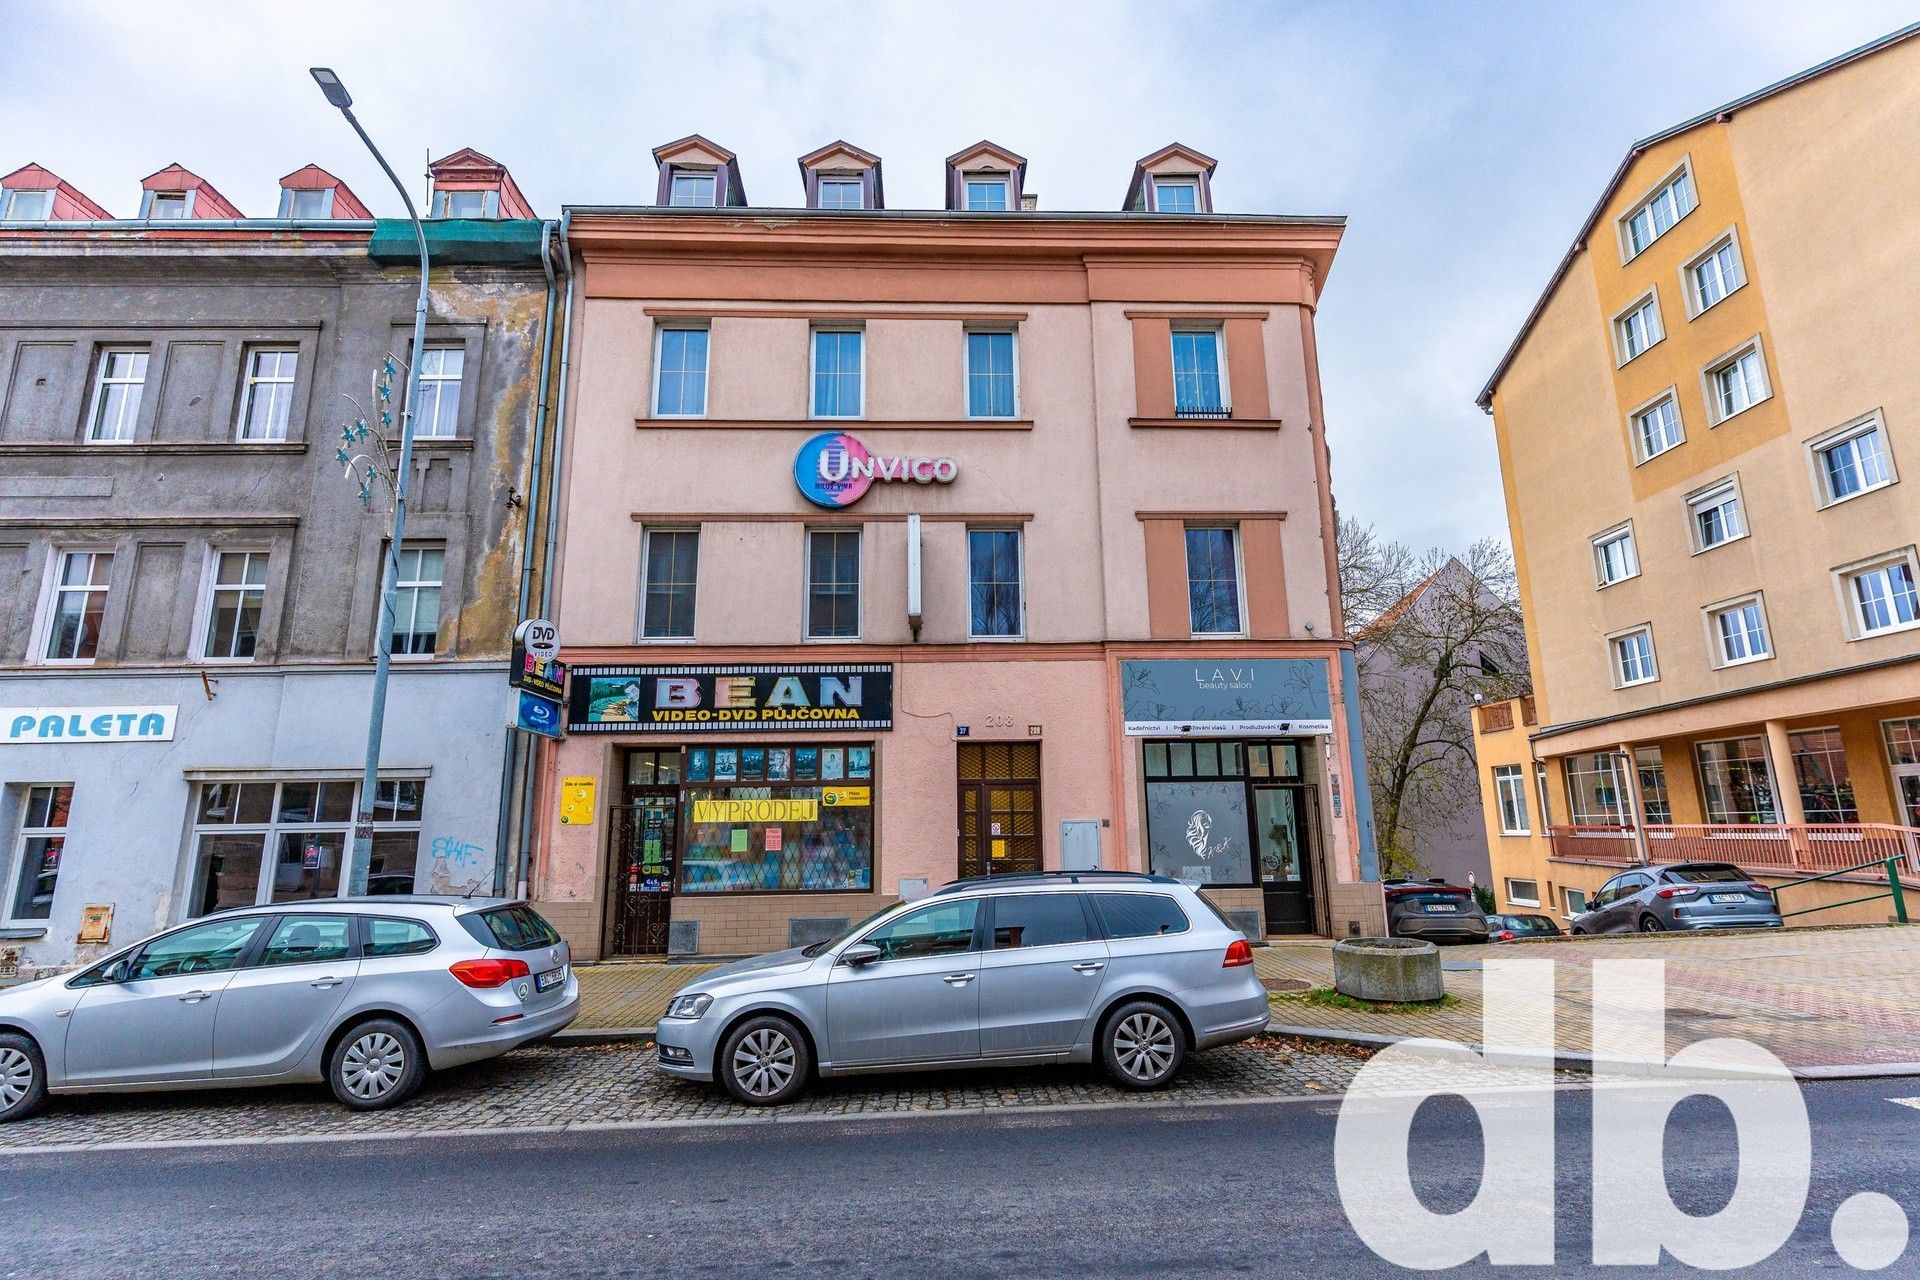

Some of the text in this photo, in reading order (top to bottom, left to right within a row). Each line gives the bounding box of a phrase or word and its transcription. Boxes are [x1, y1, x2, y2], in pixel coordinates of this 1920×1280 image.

[819, 449, 958, 484] UNVICO
[532, 626, 555, 641] DVD
[524, 653, 565, 684] BEAN
[1195, 668, 1254, 682] LAVI
[655, 676, 863, 709] BEAN
[1199, 681, 1252, 691] beauty salon
[652, 706, 860, 722] VIDEO-DVD PŮJČOVNA
[985, 714, 1015, 728] 208
[9, 713, 165, 738] PALETA
